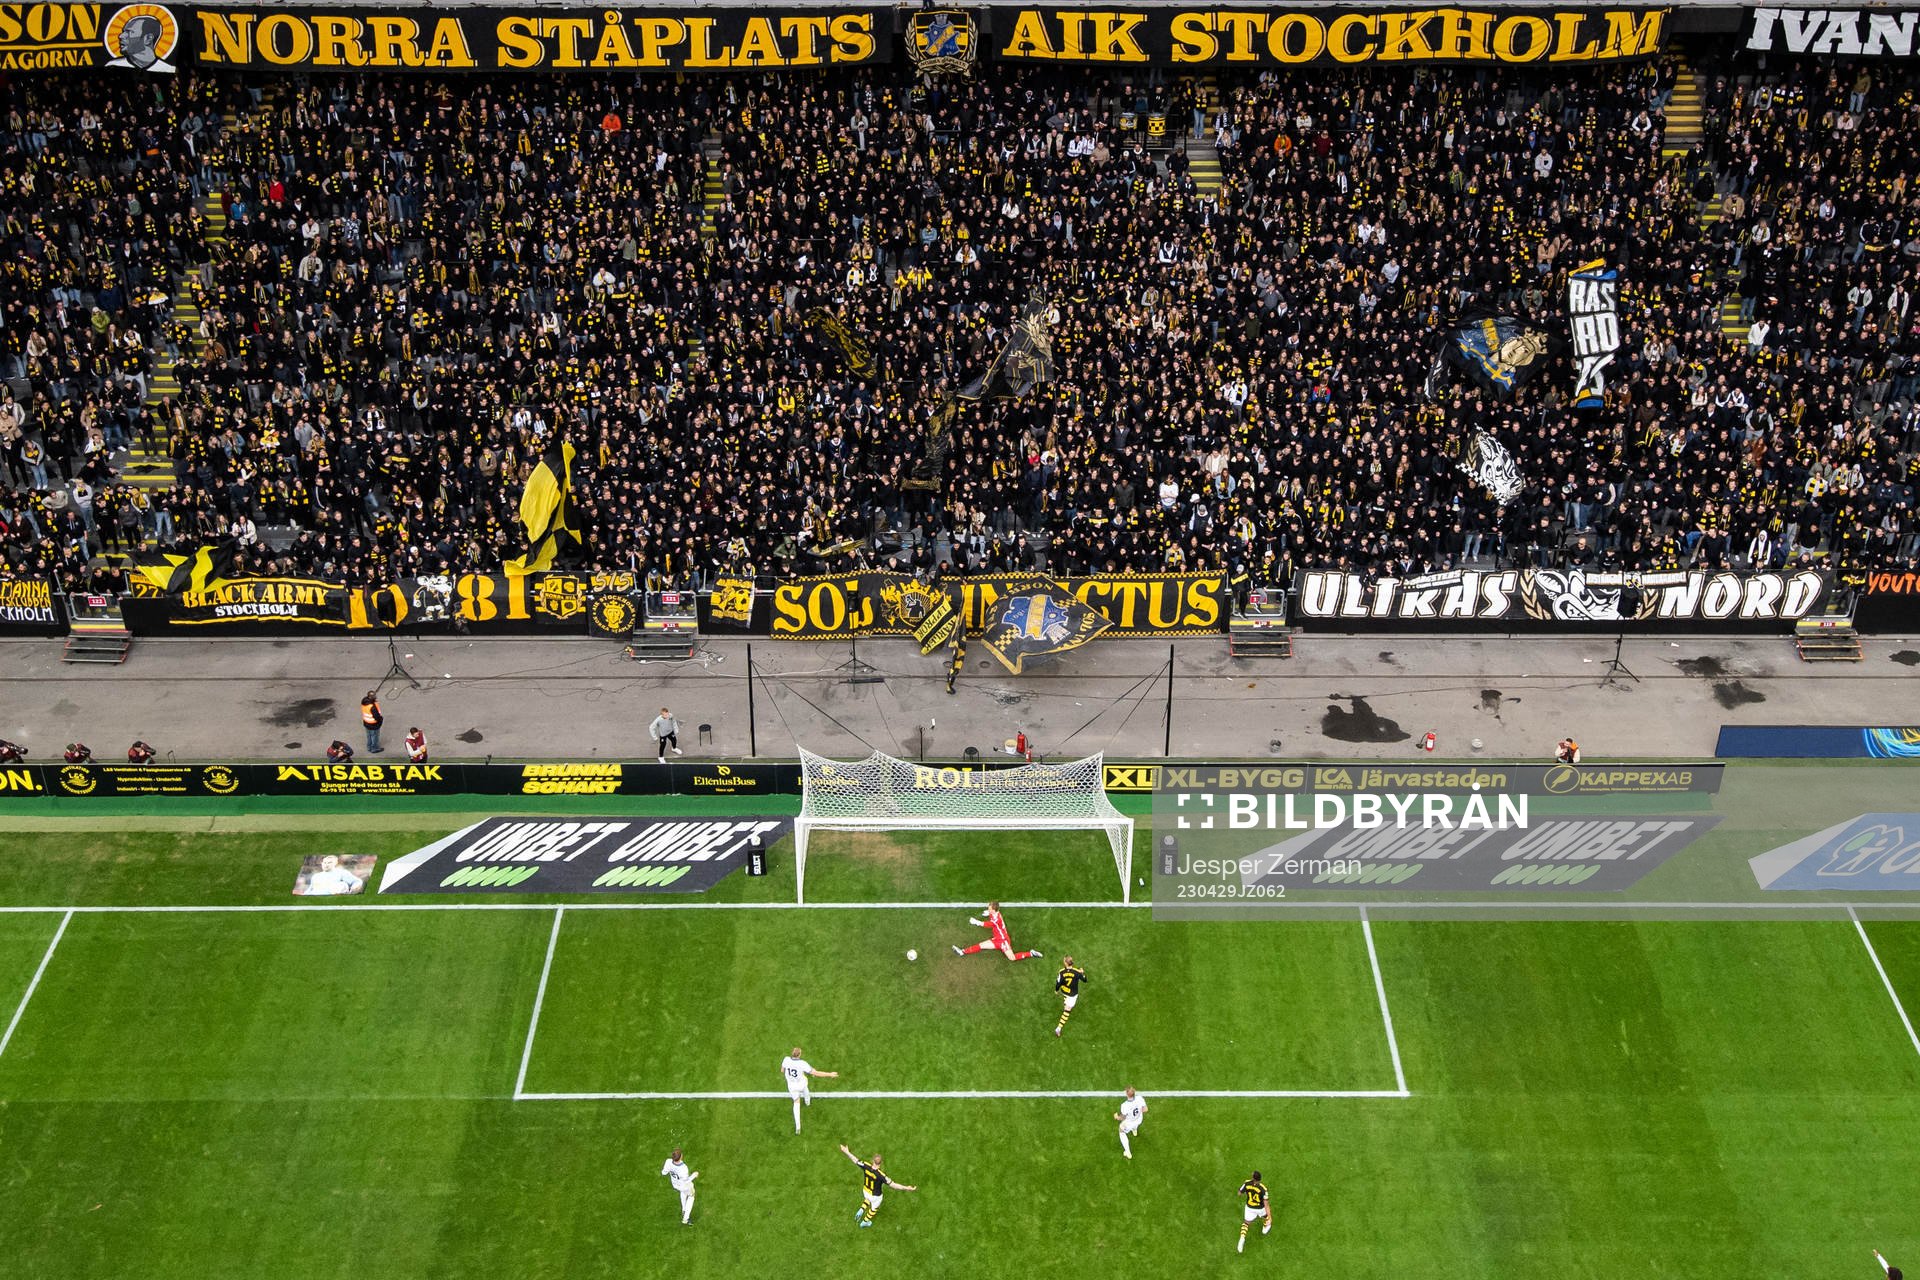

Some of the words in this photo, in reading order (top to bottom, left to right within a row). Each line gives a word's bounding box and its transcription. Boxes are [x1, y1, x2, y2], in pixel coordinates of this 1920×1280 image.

[0, 4, 101, 42] SON
[1746, 8, 1920, 56] IVAN
[198, 10, 478, 68] NORRA
[496, 9, 876, 67] STÅPLATS
[1002, 10, 1150, 62] AIK
[1170, 7, 1671, 65] STOCKHOLM
[0, 49, 94, 70] AGORNA
[182, 583, 256, 608] BLACK
[262, 583, 329, 606] ARMY
[1657, 571, 1823, 619] NORD
[215, 603, 298, 617] STOCKHOLM
[306, 765, 385, 781] TISAB
[389, 765, 443, 781] TAK
[521, 764, 622, 777] BRUNNA
[1107, 769, 1155, 787] XL
[1166, 769, 1304, 787] XL-BYGG
[1314, 768, 1353, 785] ICA
[1357, 768, 1507, 790] Järvastaden
[522, 781, 623, 794] SCHAKT
[456, 822, 632, 862] UNIBET
[608, 821, 782, 863] UNIBET
[1324, 821, 1516, 860] UNIBET
[1501, 821, 1695, 860] UNIBET
[1065, 977, 1073, 987] 7
[787, 1068, 798, 1078] 13
[1248, 1192, 1260, 1203] 14
